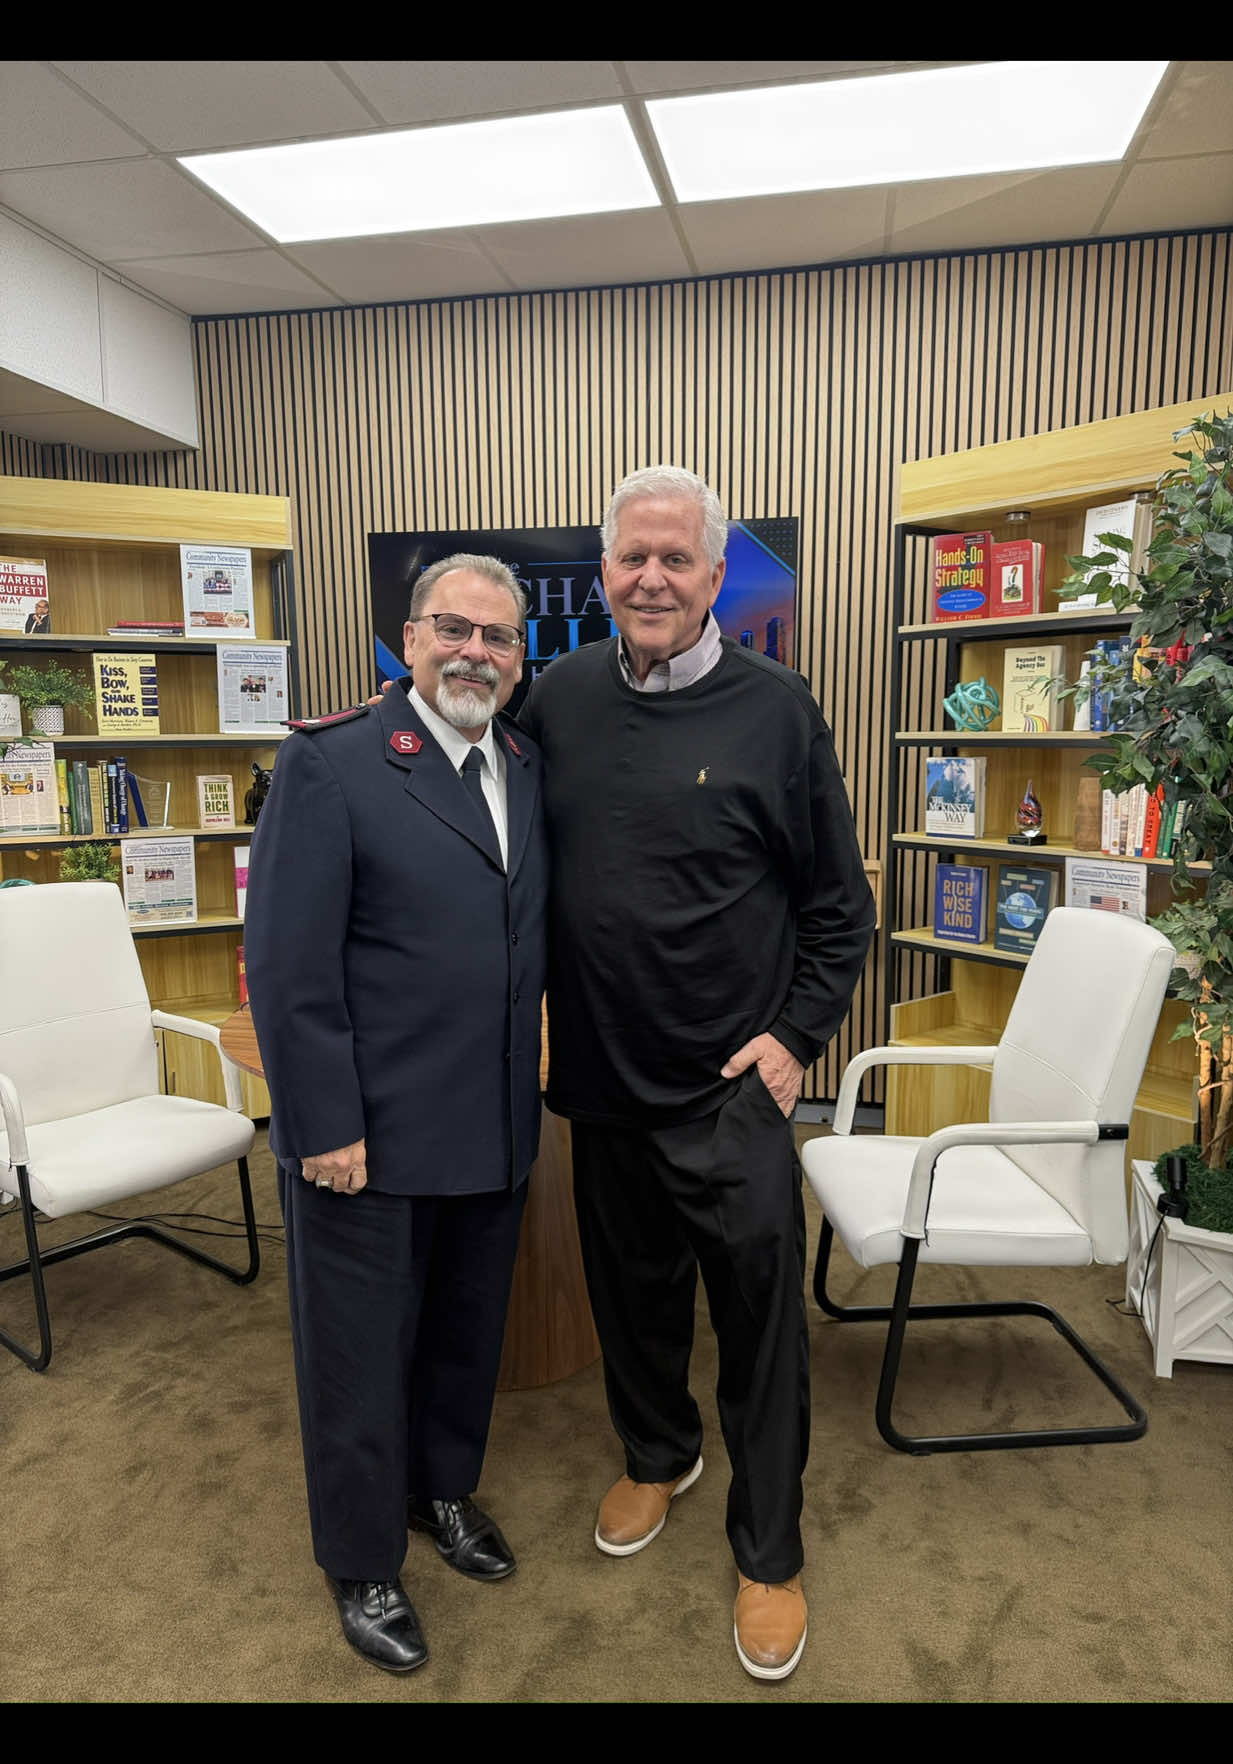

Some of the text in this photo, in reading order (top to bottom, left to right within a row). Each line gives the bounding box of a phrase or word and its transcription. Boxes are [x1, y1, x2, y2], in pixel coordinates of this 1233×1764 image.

[935, 545, 984, 567] Hands-On
[0, 574, 44, 586] WARREN
[935, 567, 984, 588] Strategy
[0, 585, 44, 595] BUFFETT
[1016, 656, 1036, 664] Beyond
[400, 736, 413, 749] S
[204, 783, 228, 792] THINK
[205, 800, 229, 812] RICH
[944, 811, 967, 824] WAY
[943, 879, 974, 897] RICH
[943, 895, 973, 913] WISE
[943, 911, 973, 929] KIND
